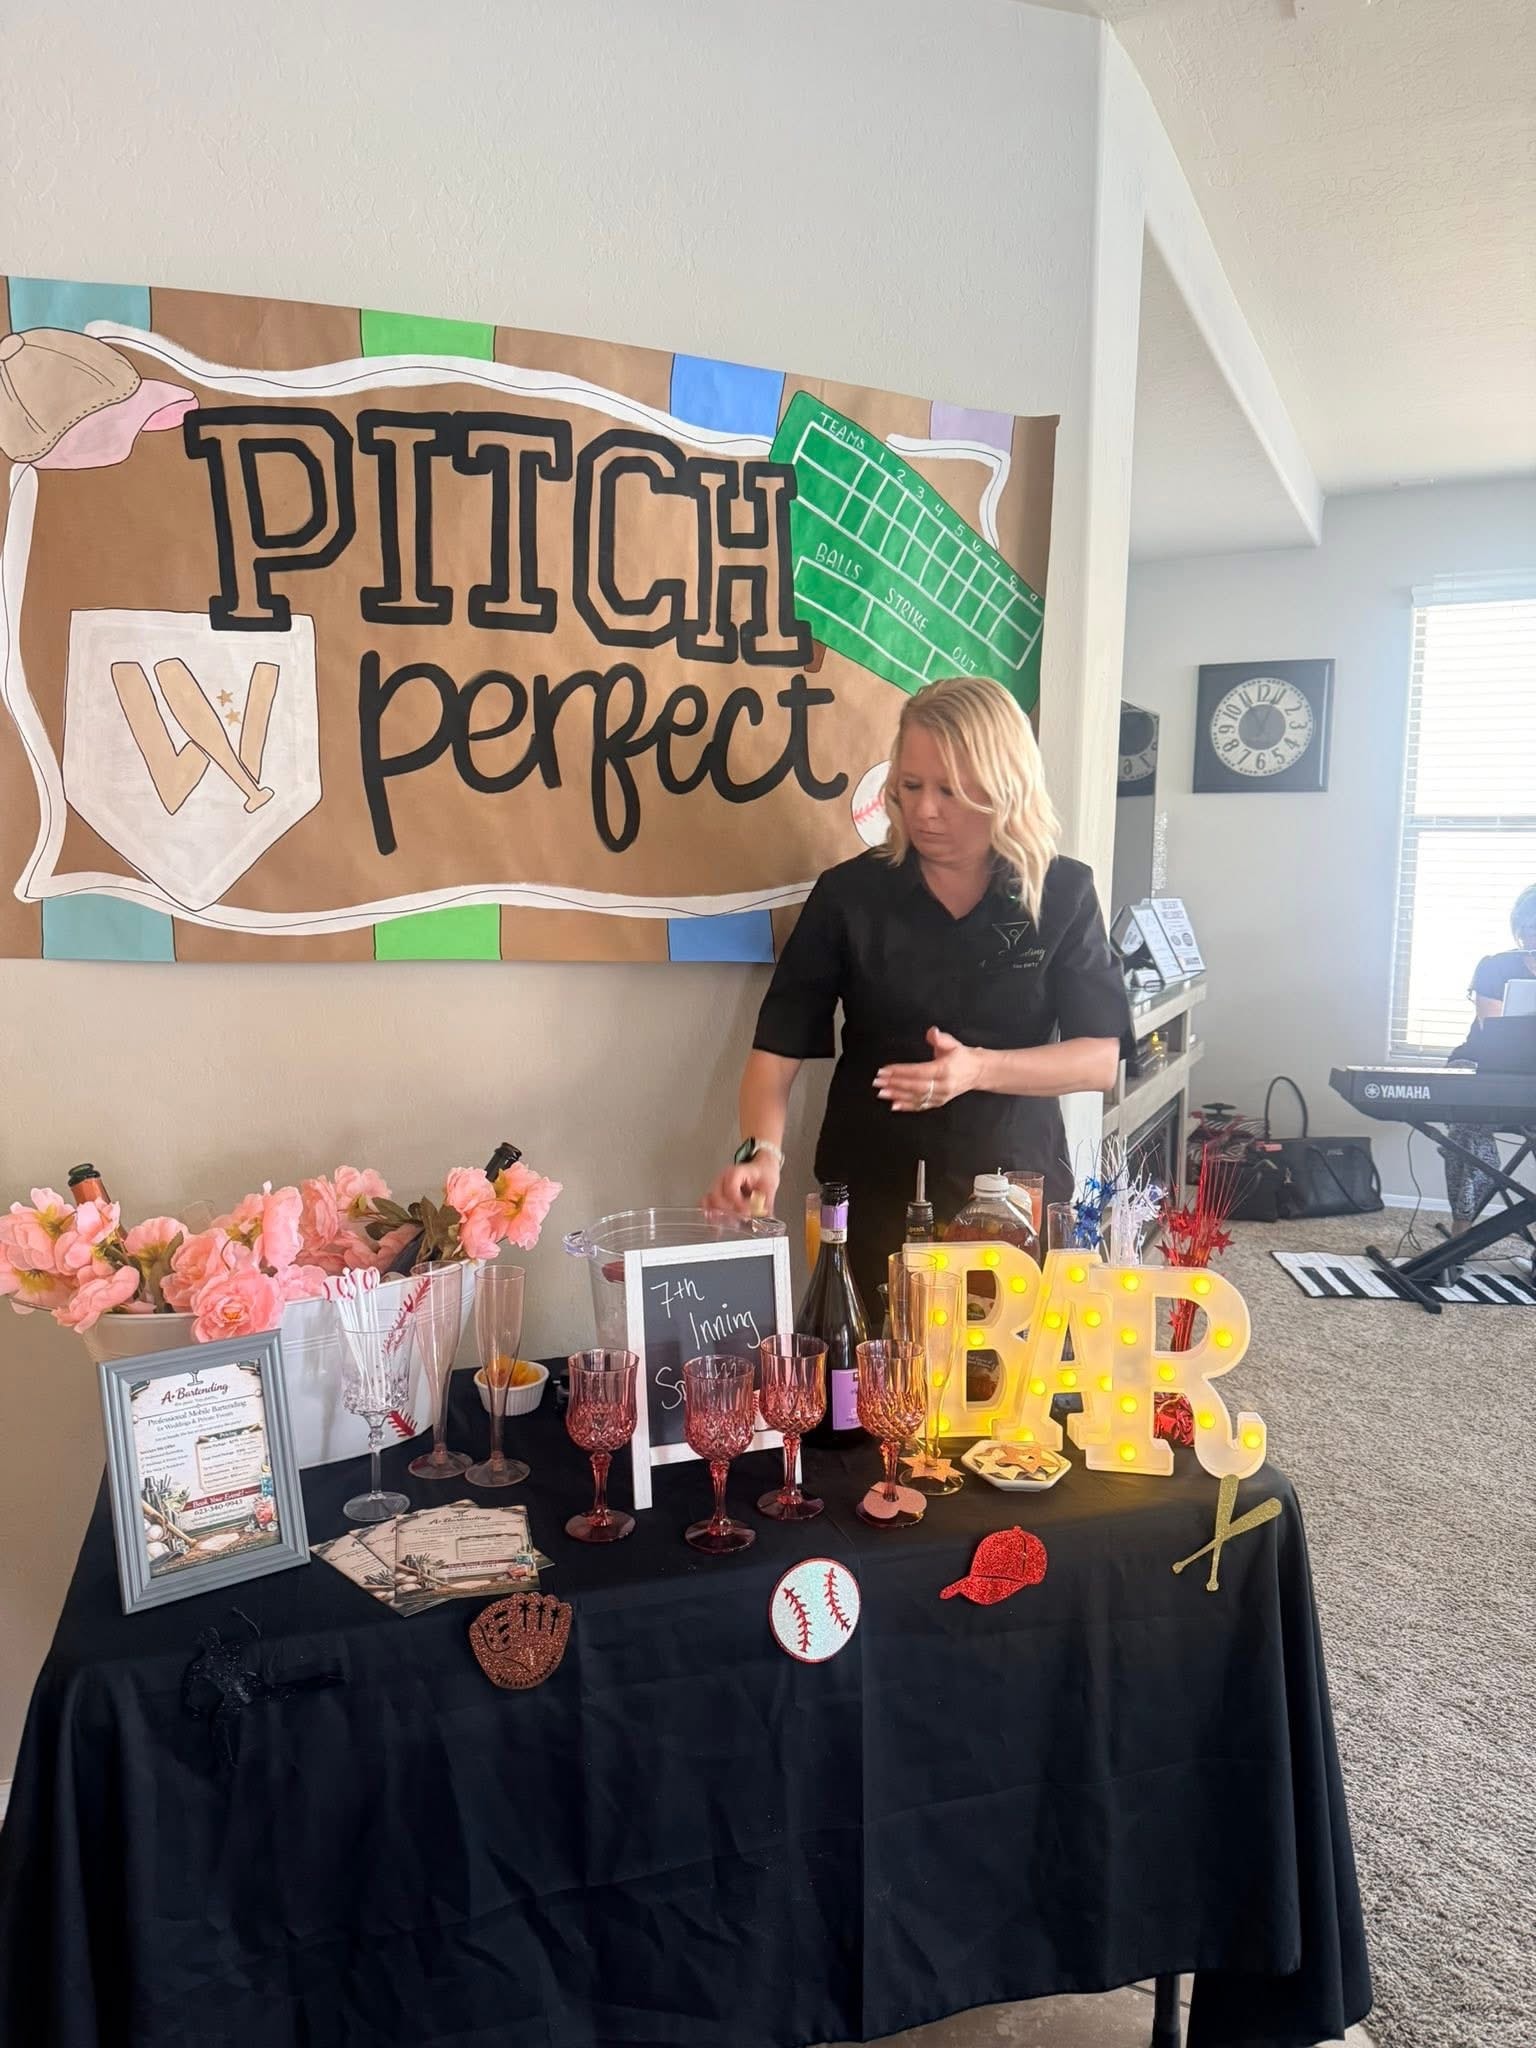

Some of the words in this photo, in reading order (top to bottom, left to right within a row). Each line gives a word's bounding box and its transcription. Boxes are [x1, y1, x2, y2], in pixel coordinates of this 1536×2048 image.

[821, 412, 865, 450] TEAMS
[879, 452, 886, 464] 1
[896, 469, 906, 484] 2
[915, 486, 925, 499] 3
[934, 504, 945, 517] 4
[954, 524, 966, 536] 5
[972, 541, 982, 553] 6
[990, 555, 1001, 570] 7
[1010, 575, 1018, 589] 8
[1030, 593, 1039, 603] 9
[185, 406, 813, 665] PITCH
[815, 543, 863, 579] BALLS
[885, 588, 929, 633] STRIKE
[952, 645, 977, 673] OUT
[1288, 720, 1307, 730] 3
[360, 650, 848, 854] perfect
[1255, 752, 1266, 770] 6
[1380, 1085, 1431, 1100] YAMAHA
[650, 1277, 705, 1319] 7th
[689, 1303, 761, 1350] Inning
[903, 1241, 1267, 1479] BAR
[176, 1382, 229, 1400] Bartending
[188, 1406, 211, 1417] Mobile
[211, 1399, 248, 1412] Bartending
